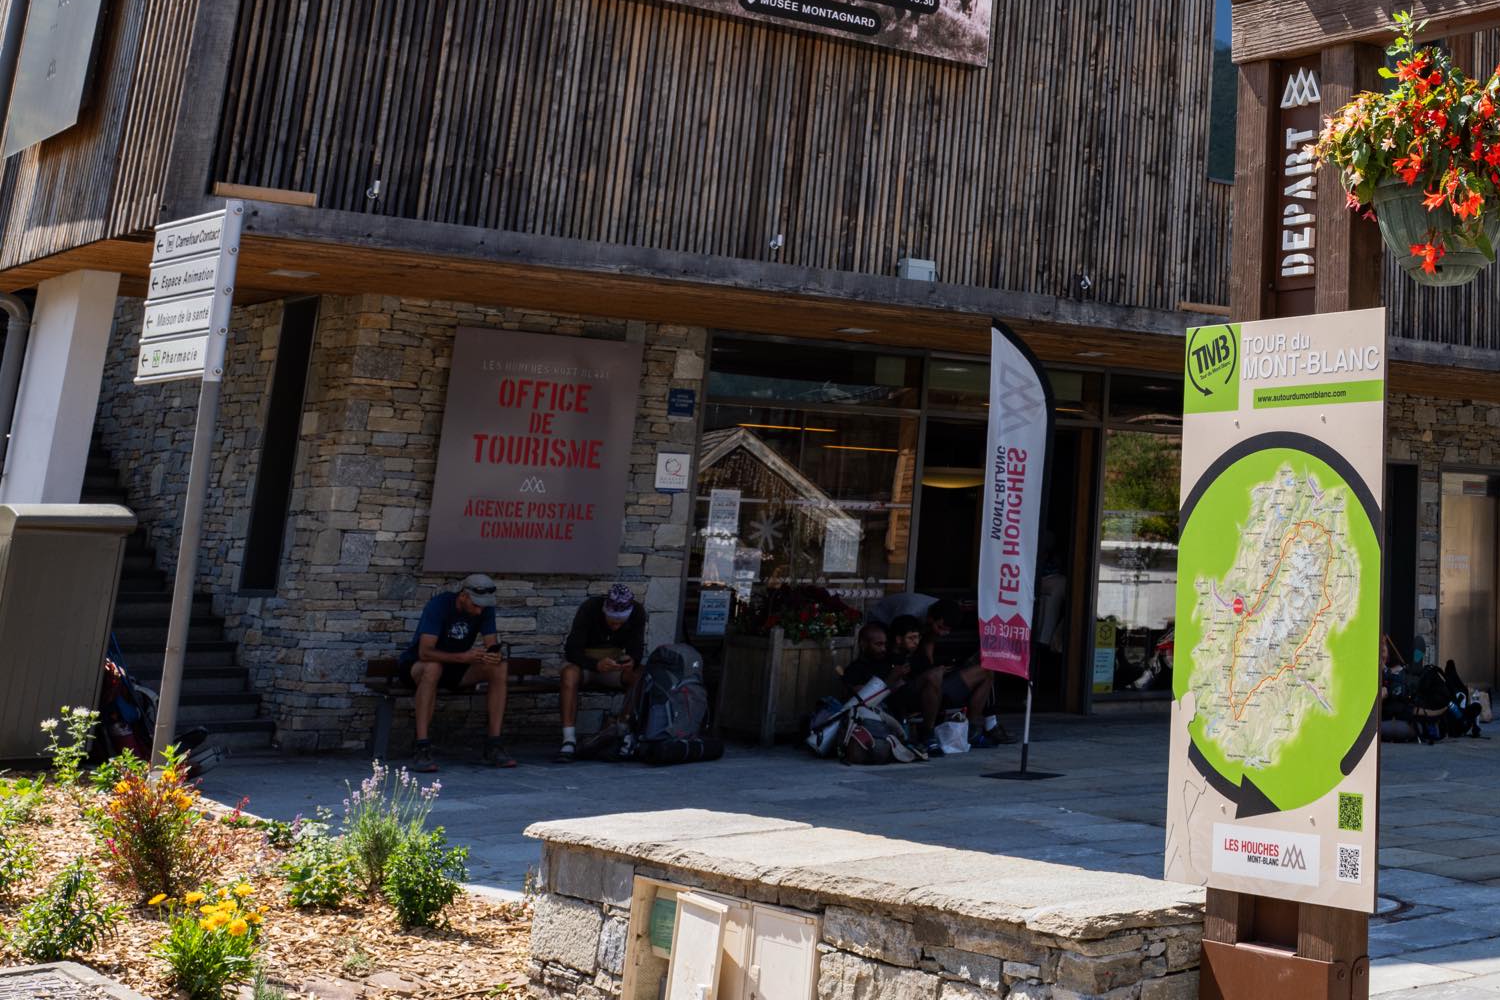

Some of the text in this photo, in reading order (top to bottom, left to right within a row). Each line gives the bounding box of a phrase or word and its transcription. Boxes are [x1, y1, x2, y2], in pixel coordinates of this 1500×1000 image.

[802, 3, 876, 29] MONTAGNARD
[1281, 127, 1317, 278] DEPART
[161, 271, 214, 291] Espace Animation
[156, 313, 177, 326] Maison
[177, 312, 185, 323] de
[1243, 333, 1311, 354] TOUR du
[161, 350, 197, 364] Pharmacie
[1192, 335, 1230, 374] TMB
[1243, 346, 1380, 380] MONT-BLANC
[498, 378, 593, 413] OFFICE
[1257, 389, 1347, 403] www.autourdumontblanc.com
[528, 413, 554, 434] DE
[473, 434, 604, 470] TOURISME
[464, 499, 595, 521] AGENCE POSTALE
[480, 522, 574, 541] COMMUNALE
[1224, 838, 1280, 857] LES HOUCHES
[1247, 854, 1280, 866] MONT-BLANC
